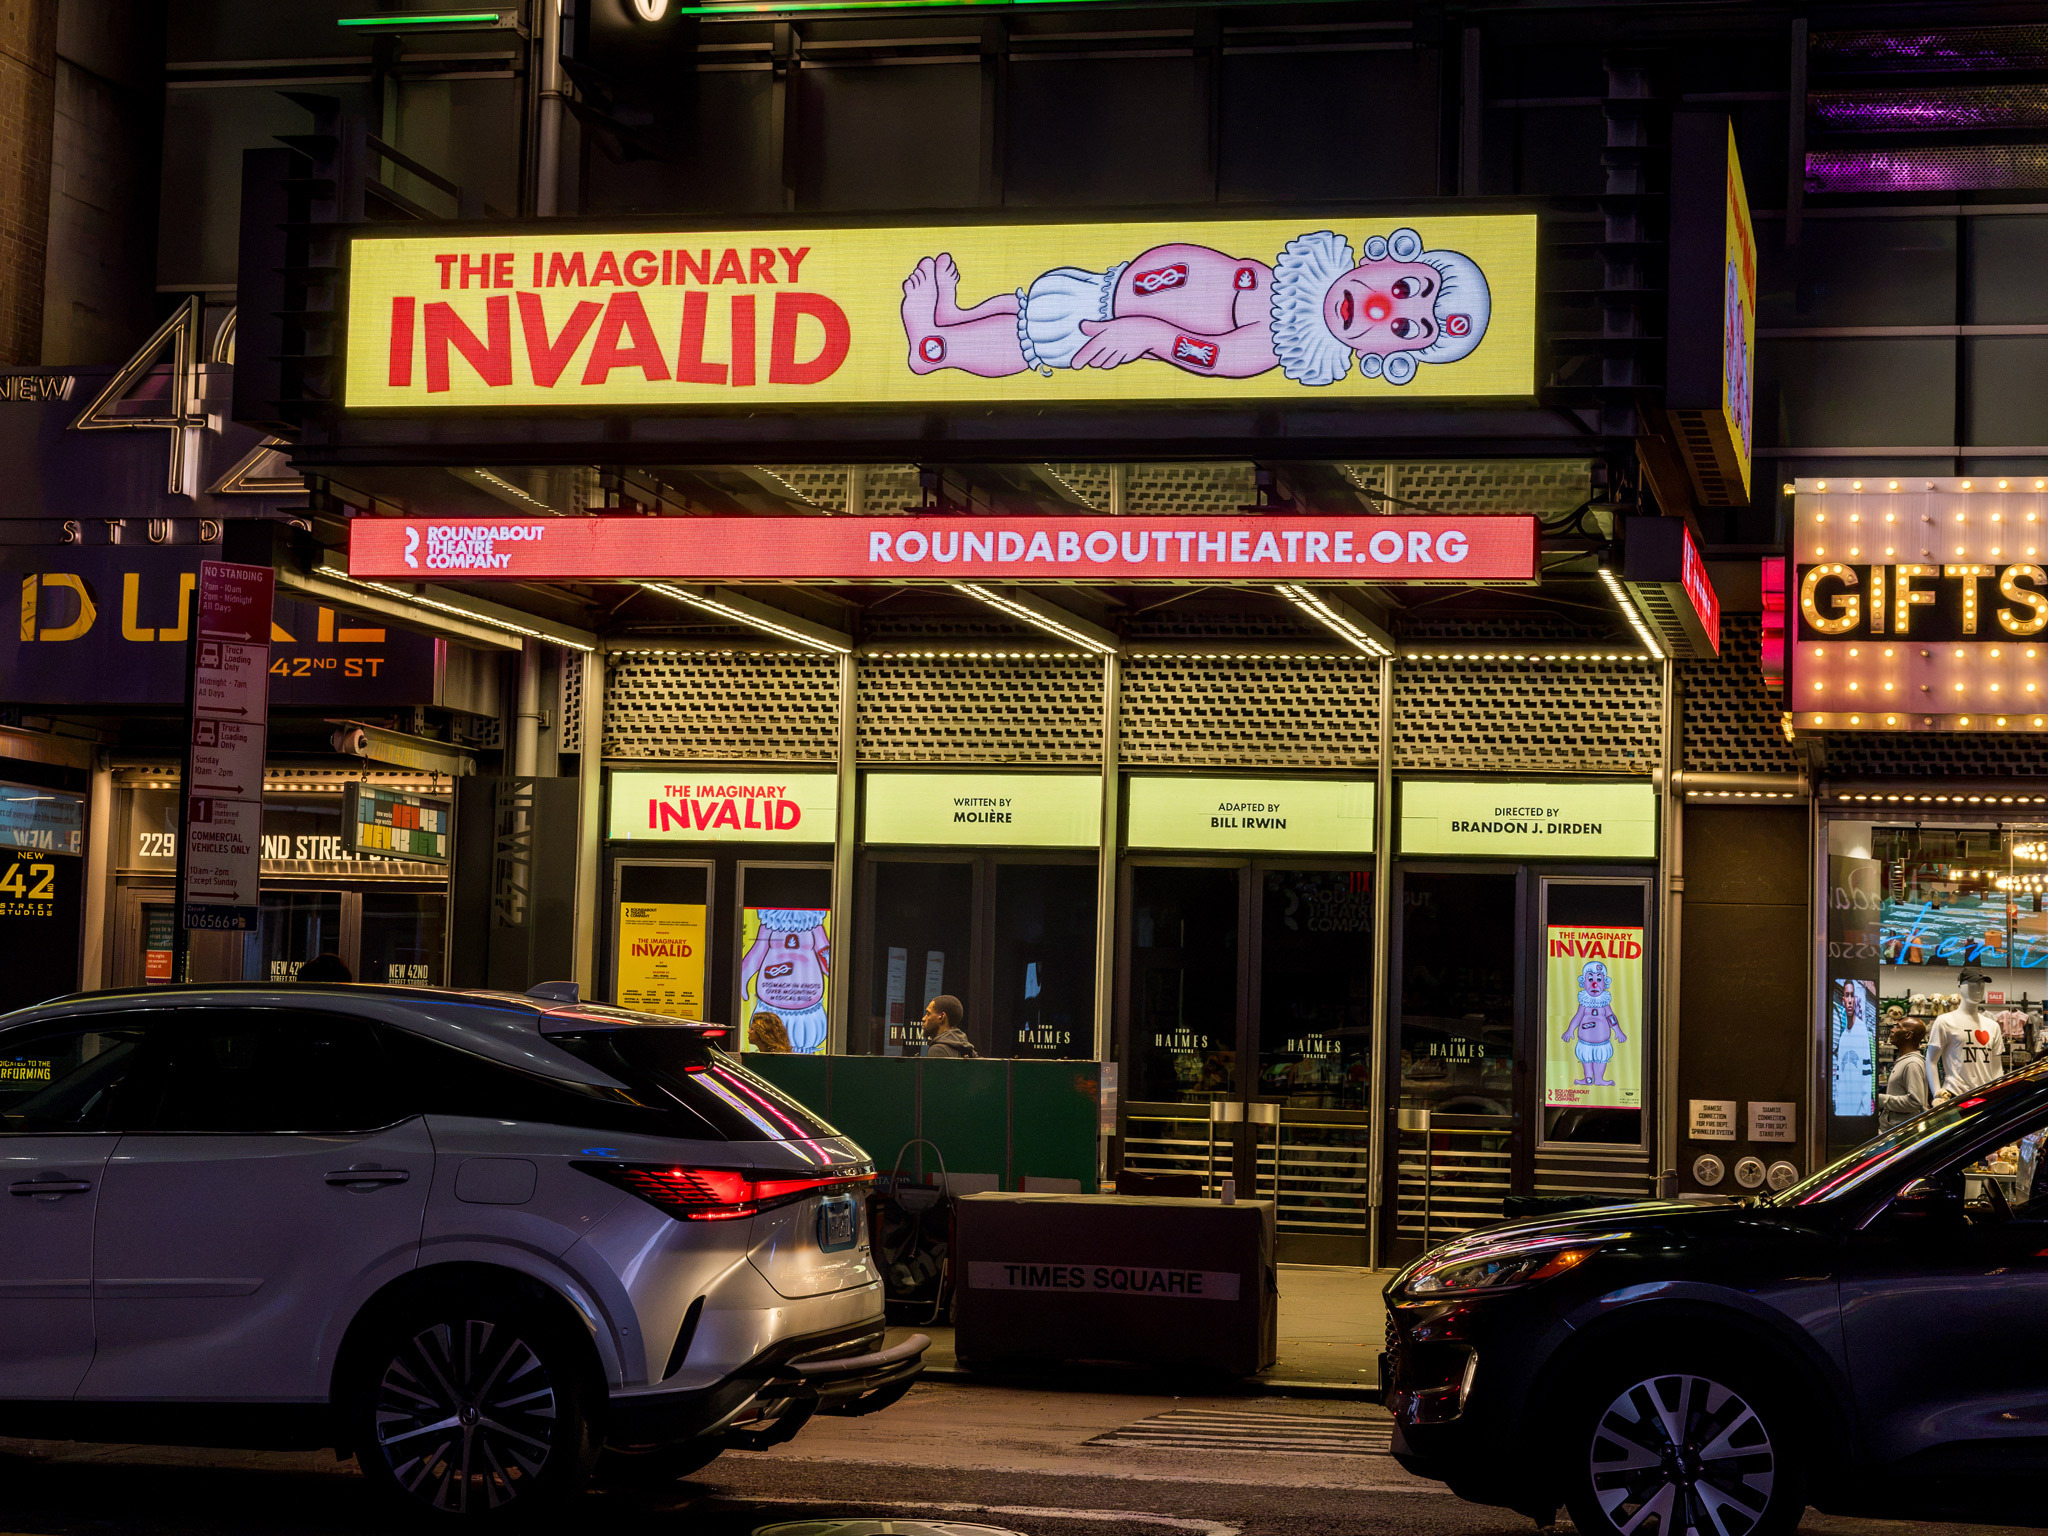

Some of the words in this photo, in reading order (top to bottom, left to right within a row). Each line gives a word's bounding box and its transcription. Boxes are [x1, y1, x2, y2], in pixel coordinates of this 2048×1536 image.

[435, 253, 515, 289] THE
[533, 247, 811, 288] IMAGINARY
[388, 291, 851, 393] INVALID
[427, 526, 545, 541] ROUNDABOUT
[427, 540, 493, 554] THEATRE
[868, 530, 1470, 564] ROUNDABOUTTHEATRE.ORG
[426, 554, 512, 568] COMPANY
[204, 566, 218, 577] NO
[220, 568, 263, 582] STANDING
[224, 594, 252, 605] Midnight
[1800, 563, 2048, 635] GIFTS
[203, 602, 213, 610] All
[214, 602, 231, 613] Days
[225, 646, 244, 655] Truck
[224, 655, 251, 665] Loading
[224, 663, 240, 673] Only
[270, 657, 337, 677] 42ND
[344, 658, 384, 678] ST
[199, 677, 227, 687] Midnight
[208, 688, 225, 698] Days
[222, 724, 240, 733] Truck
[221, 732, 248, 743] Loading
[220, 741, 236, 751] Only
[195, 755, 220, 766] Sunday
[194, 766, 212, 775] 10am
[218, 768, 234, 777] 2pm
[664, 785, 691, 797] THE
[696, 785, 787, 798] IMAGINARY
[953, 798, 997, 807] WRITTEN
[999, 798, 1012, 807] BY
[1218, 802, 1265, 812] ADAPTED
[1267, 804, 1280, 812] BY
[198, 800, 205, 821] 1
[214, 810, 239, 818] metered
[649, 798, 801, 832] INVALID
[953, 808, 1012, 823] MOLIÈRE
[1495, 807, 1544, 816] DIRECTED
[1546, 808, 1560, 817] BY
[1211, 817, 1238, 828] BILL
[1242, 817, 1287, 829] IRWIN
[1451, 821, 1528, 833] BRANDON
[1531, 823, 1543, 834] J.
[1547, 823, 1602, 834] DIRDEN
[191, 831, 243, 843] COMMERCIAL
[139, 833, 175, 857] 229
[296, 836, 361, 860] STRE
[191, 842, 229, 854] VEHICLES
[230, 845, 251, 855] ONLY
[18, 851, 45, 860] NEW
[190, 866, 209, 875] 10am
[214, 867, 229, 876] 2pm
[0, 863, 55, 899] 42
[189, 876, 212, 886] Except
[213, 877, 238, 888] Sunday
[0, 909, 53, 917] STUDIOS
[1308, 903, 1371, 919] THEATR
[187, 914, 230, 928] 106566
[1307, 917, 1371, 932] COMPA
[1559, 931, 1575, 940] THE
[1578, 932, 1633, 940] IMAGINARY
[631, 943, 693, 958] INVALID
[1550, 939, 1642, 960] INVALID
[270, 960, 288, 976] NEW
[388, 963, 405, 979] NEW
[407, 964, 429, 979] 42ND
[890, 1026, 925, 1040] HAIM
[1018, 1030, 1071, 1044] HAIMES
[1964, 1029, 1974, 1045] I
[1155, 1033, 1208, 1048] HAIMES
[1287, 1039, 1341, 1053] HAIMES
[1430, 1043, 1485, 1058] HAIMES
[1962, 1047, 1992, 1063] NY
[38, 1060, 51, 1068] THE
[1004, 1265, 1085, 1288] TIMES
[1093, 1267, 1203, 1294] SQUARE
